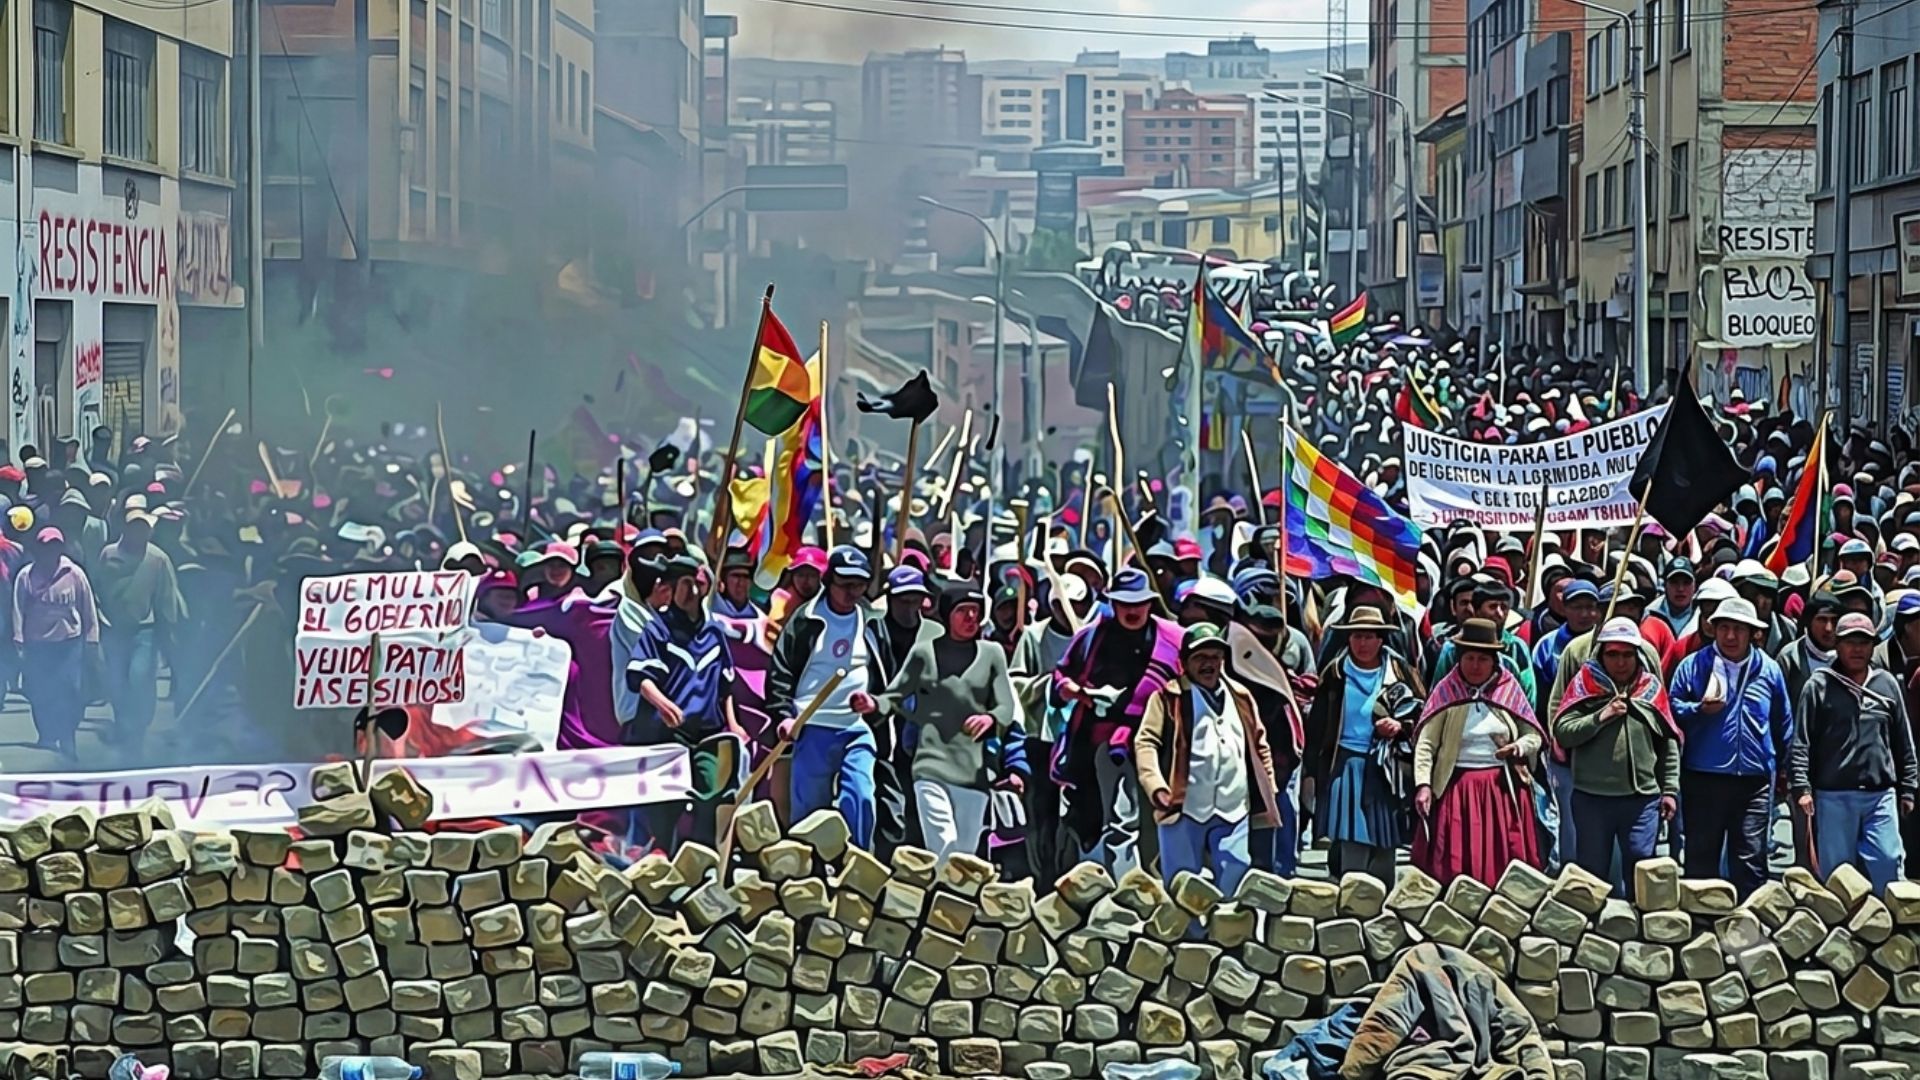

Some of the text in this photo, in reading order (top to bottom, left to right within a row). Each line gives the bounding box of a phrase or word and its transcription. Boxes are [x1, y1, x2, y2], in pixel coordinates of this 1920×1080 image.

[39, 209, 170, 300] RESISTENCIA
[1728, 314, 1815, 337] BLOQUEO
[1407, 431, 1492, 465] JUSTICIA
[1554, 440, 1578, 462] EL
[1583, 415, 1660, 457] PUEBLO
[1497, 469, 1517, 486] LA
